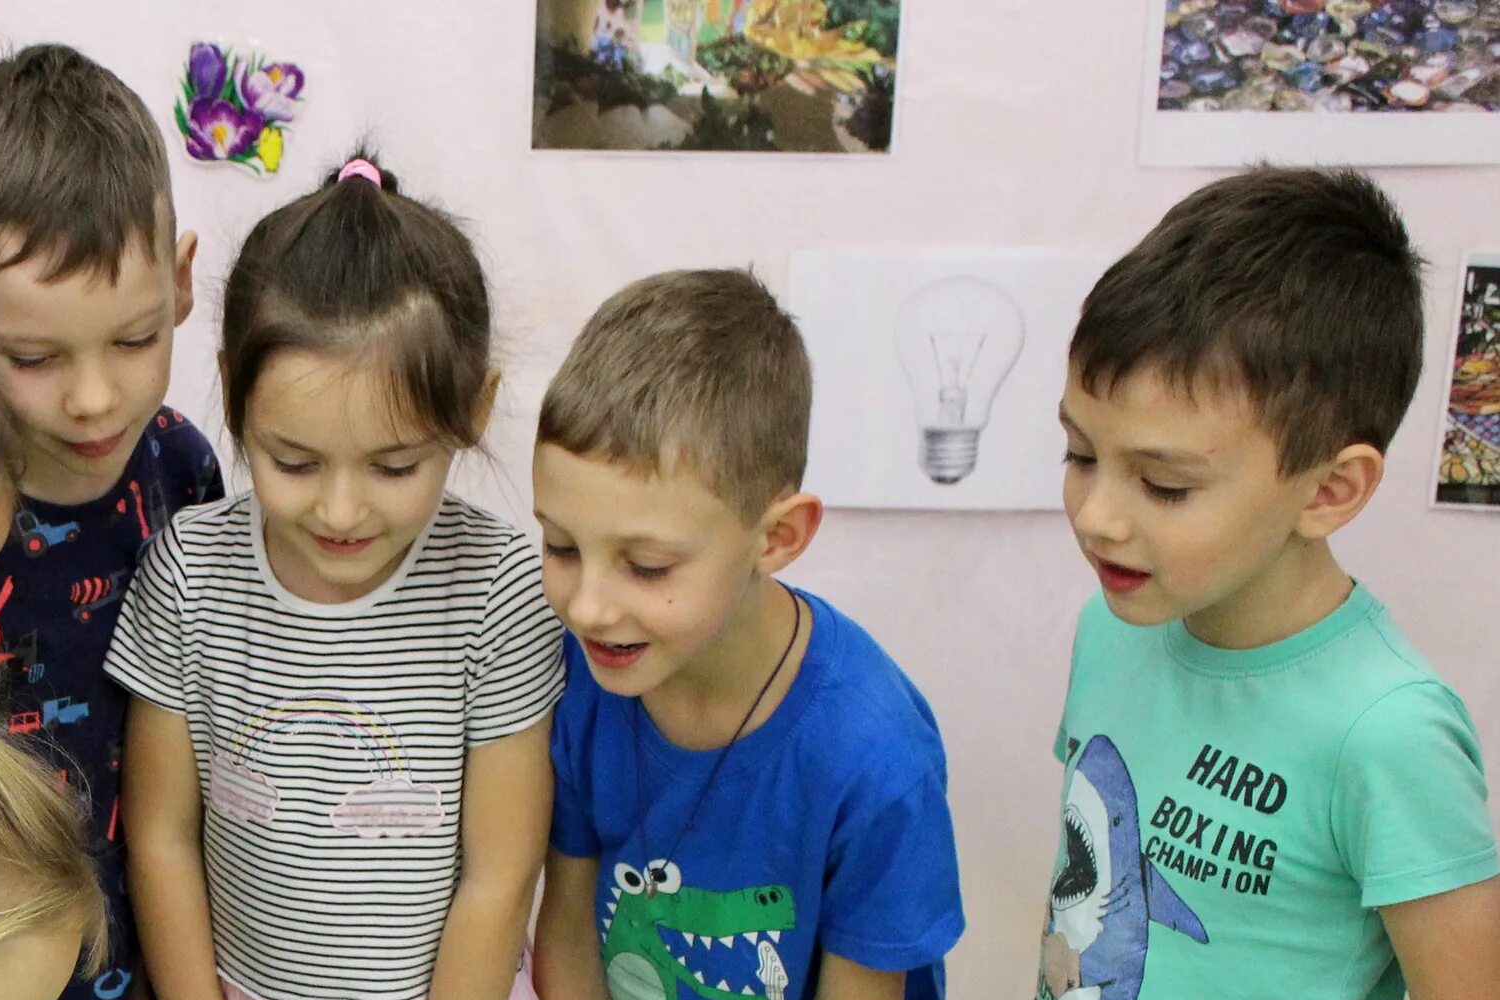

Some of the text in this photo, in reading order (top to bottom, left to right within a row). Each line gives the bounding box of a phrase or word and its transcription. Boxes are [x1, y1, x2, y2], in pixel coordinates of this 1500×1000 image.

[1186, 744, 1287, 815] HARD
[1145, 836, 1271, 896] CHAMPION
[1150, 796, 1278, 871] BOXING
